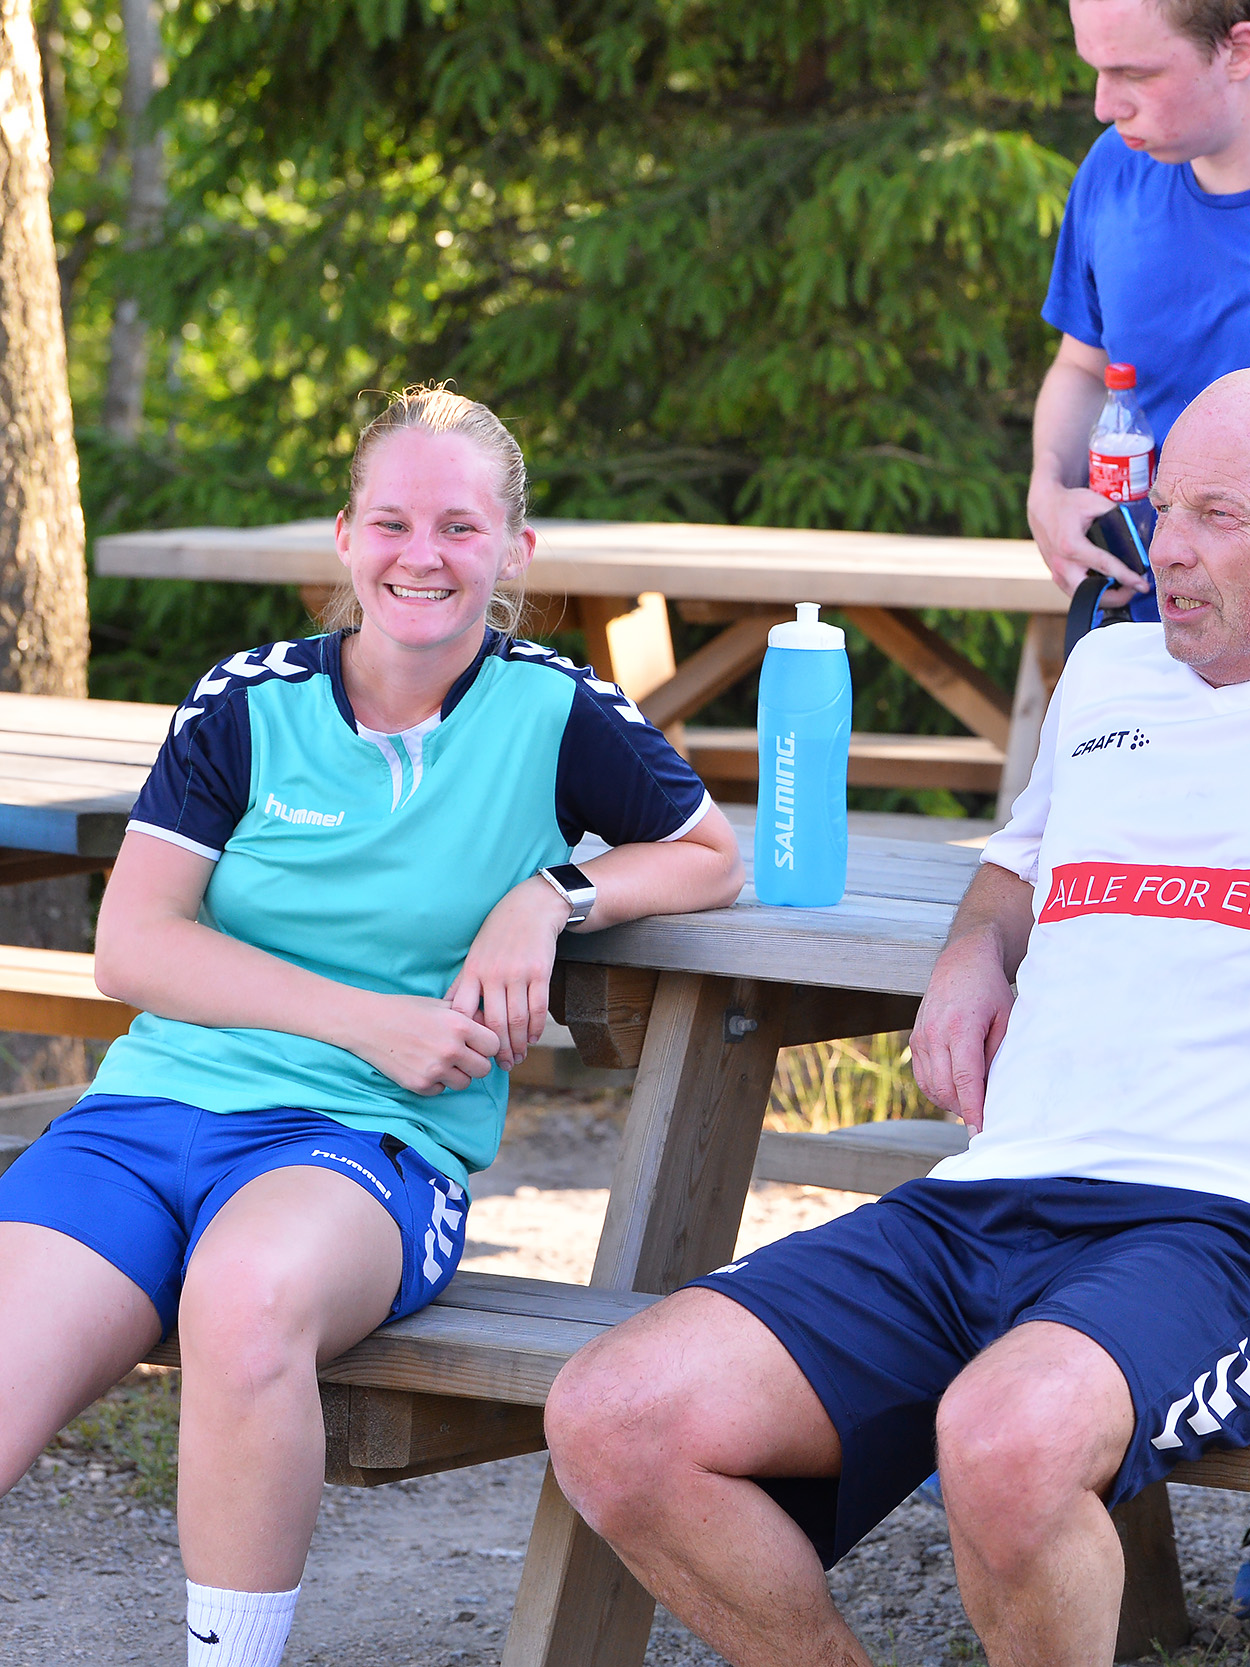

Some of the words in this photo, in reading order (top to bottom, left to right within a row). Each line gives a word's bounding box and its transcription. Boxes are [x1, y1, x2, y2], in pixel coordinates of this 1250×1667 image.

[1071, 730, 1131, 758] CRAFT
[264, 793, 346, 827] hummel
[1046, 875, 1128, 911] ALLE
[1132, 876, 1211, 909] FOR
[311, 1149, 392, 1200] hummel
